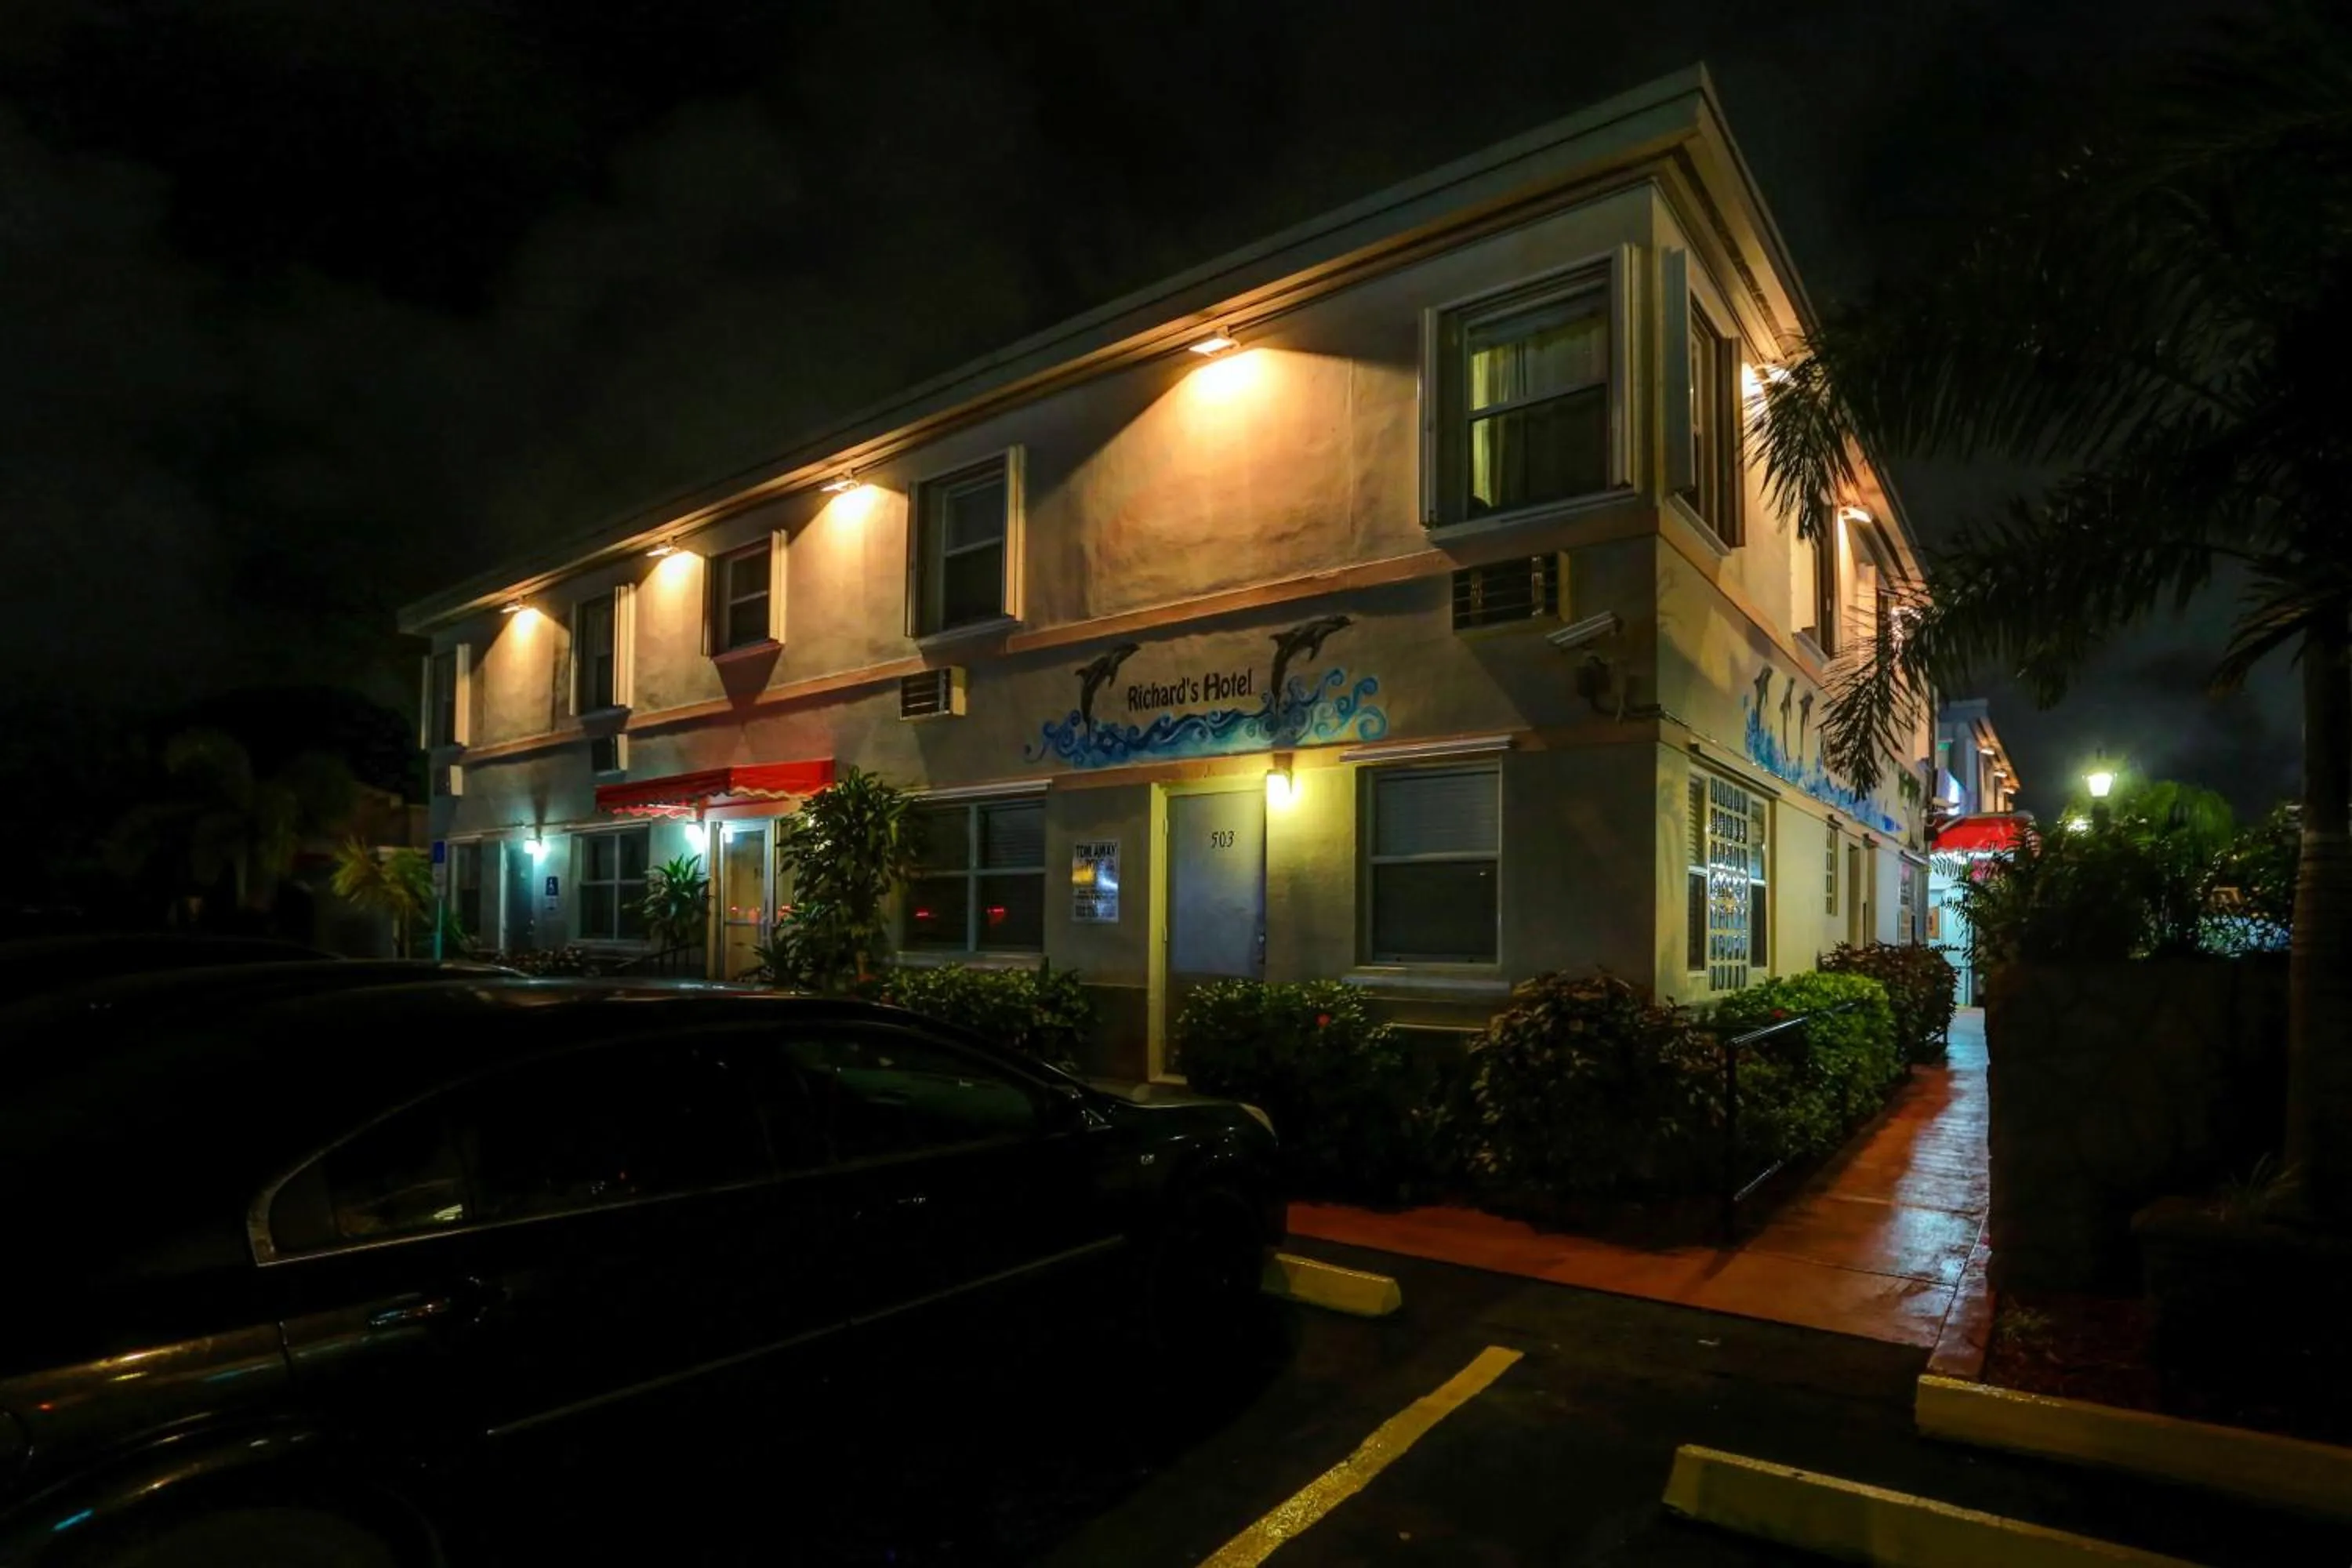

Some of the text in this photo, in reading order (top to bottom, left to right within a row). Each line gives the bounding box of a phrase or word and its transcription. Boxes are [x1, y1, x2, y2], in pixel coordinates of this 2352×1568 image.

[1127, 667, 1253, 711] Richard's Hotel
[1211, 830, 1234, 849] 503
[1094, 844, 1116, 858] AWAY
